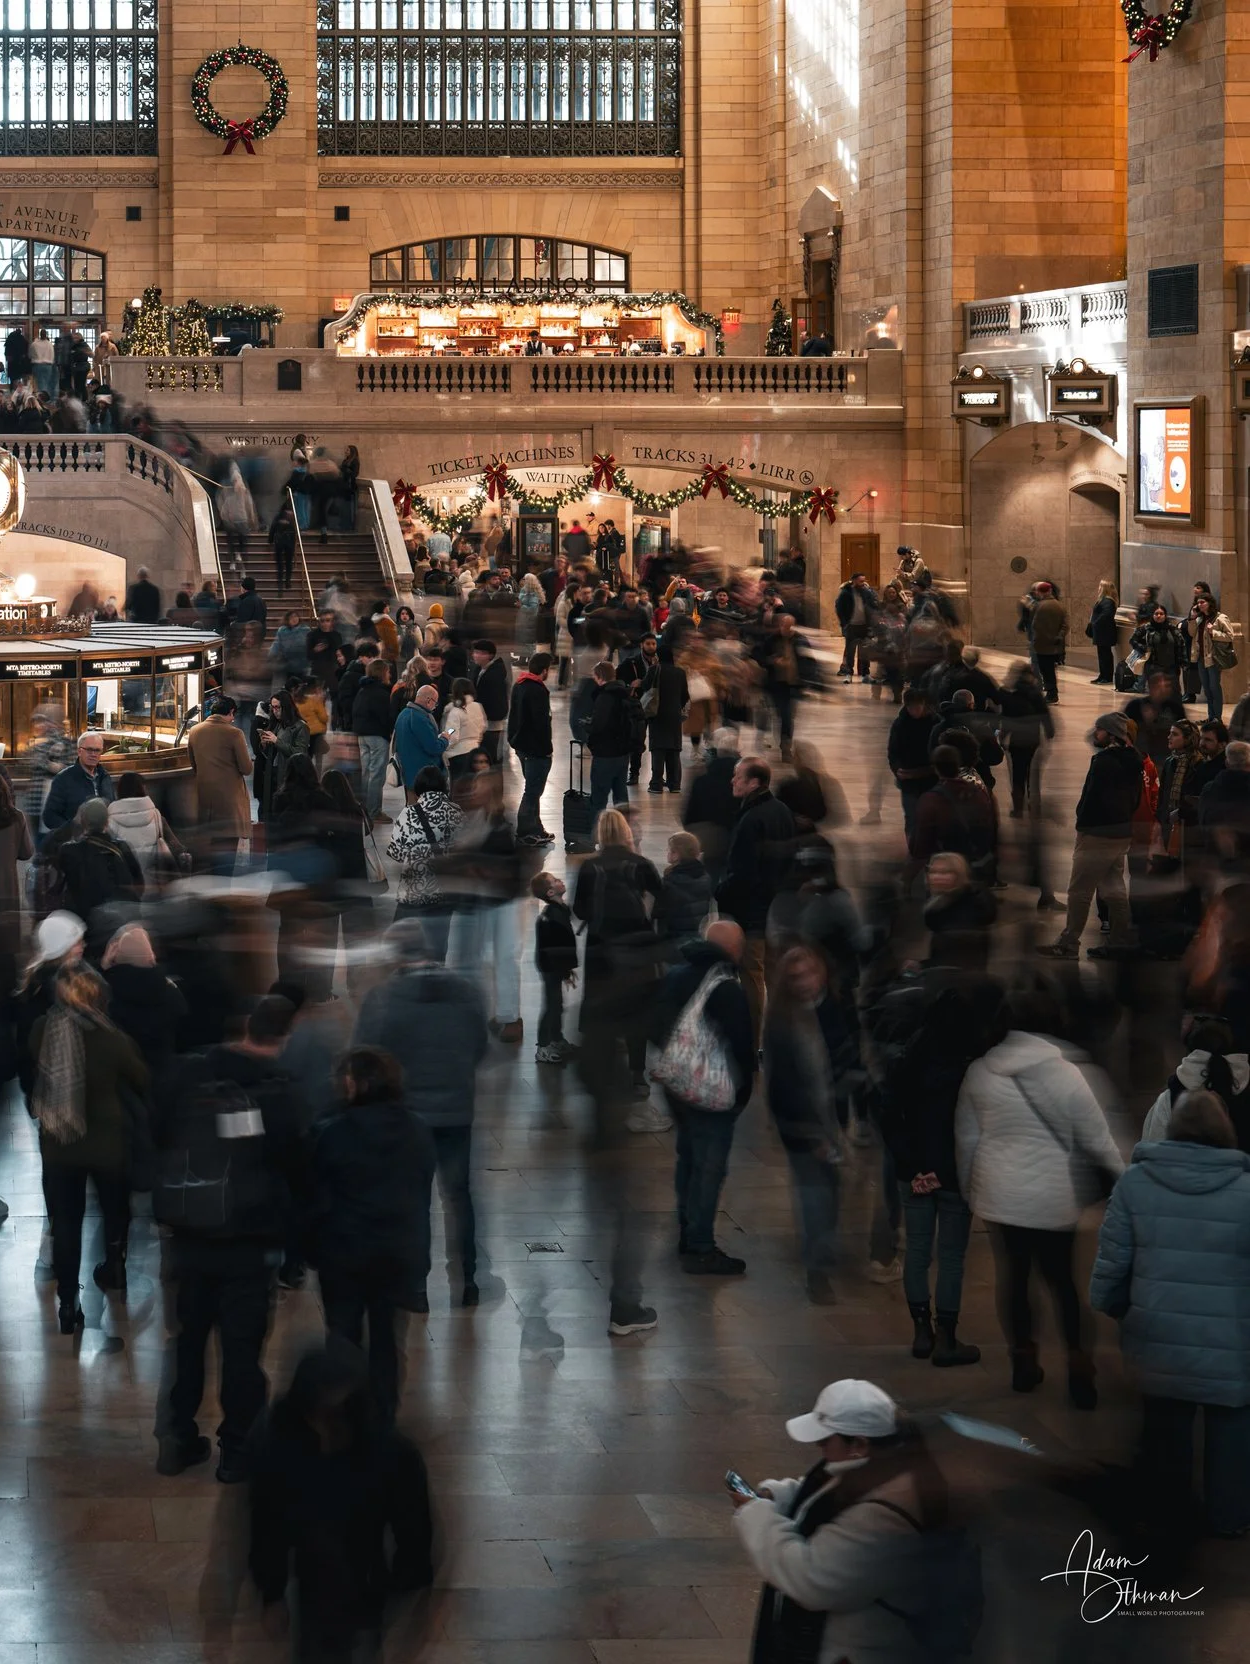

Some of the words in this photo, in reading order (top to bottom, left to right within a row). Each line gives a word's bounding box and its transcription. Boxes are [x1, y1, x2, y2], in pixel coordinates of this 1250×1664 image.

[14, 205, 79, 225] AVENUE
[452, 277, 596, 294] PALLADINO'S
[224, 436, 259, 446] WEST
[428, 455, 484, 476] TICKET
[490, 446, 575, 466] MACHINES
[632, 446, 695, 463] TRACKS
[698, 453, 713, 466] 31
[726, 457, 744, 471] 42
[760, 463, 795, 482] LIRR
[15, 521, 56, 534] TRACKS
[58, 528, 75, 539] 102
[78, 532, 91, 543] TO
[94, 537, 109, 549] 114
